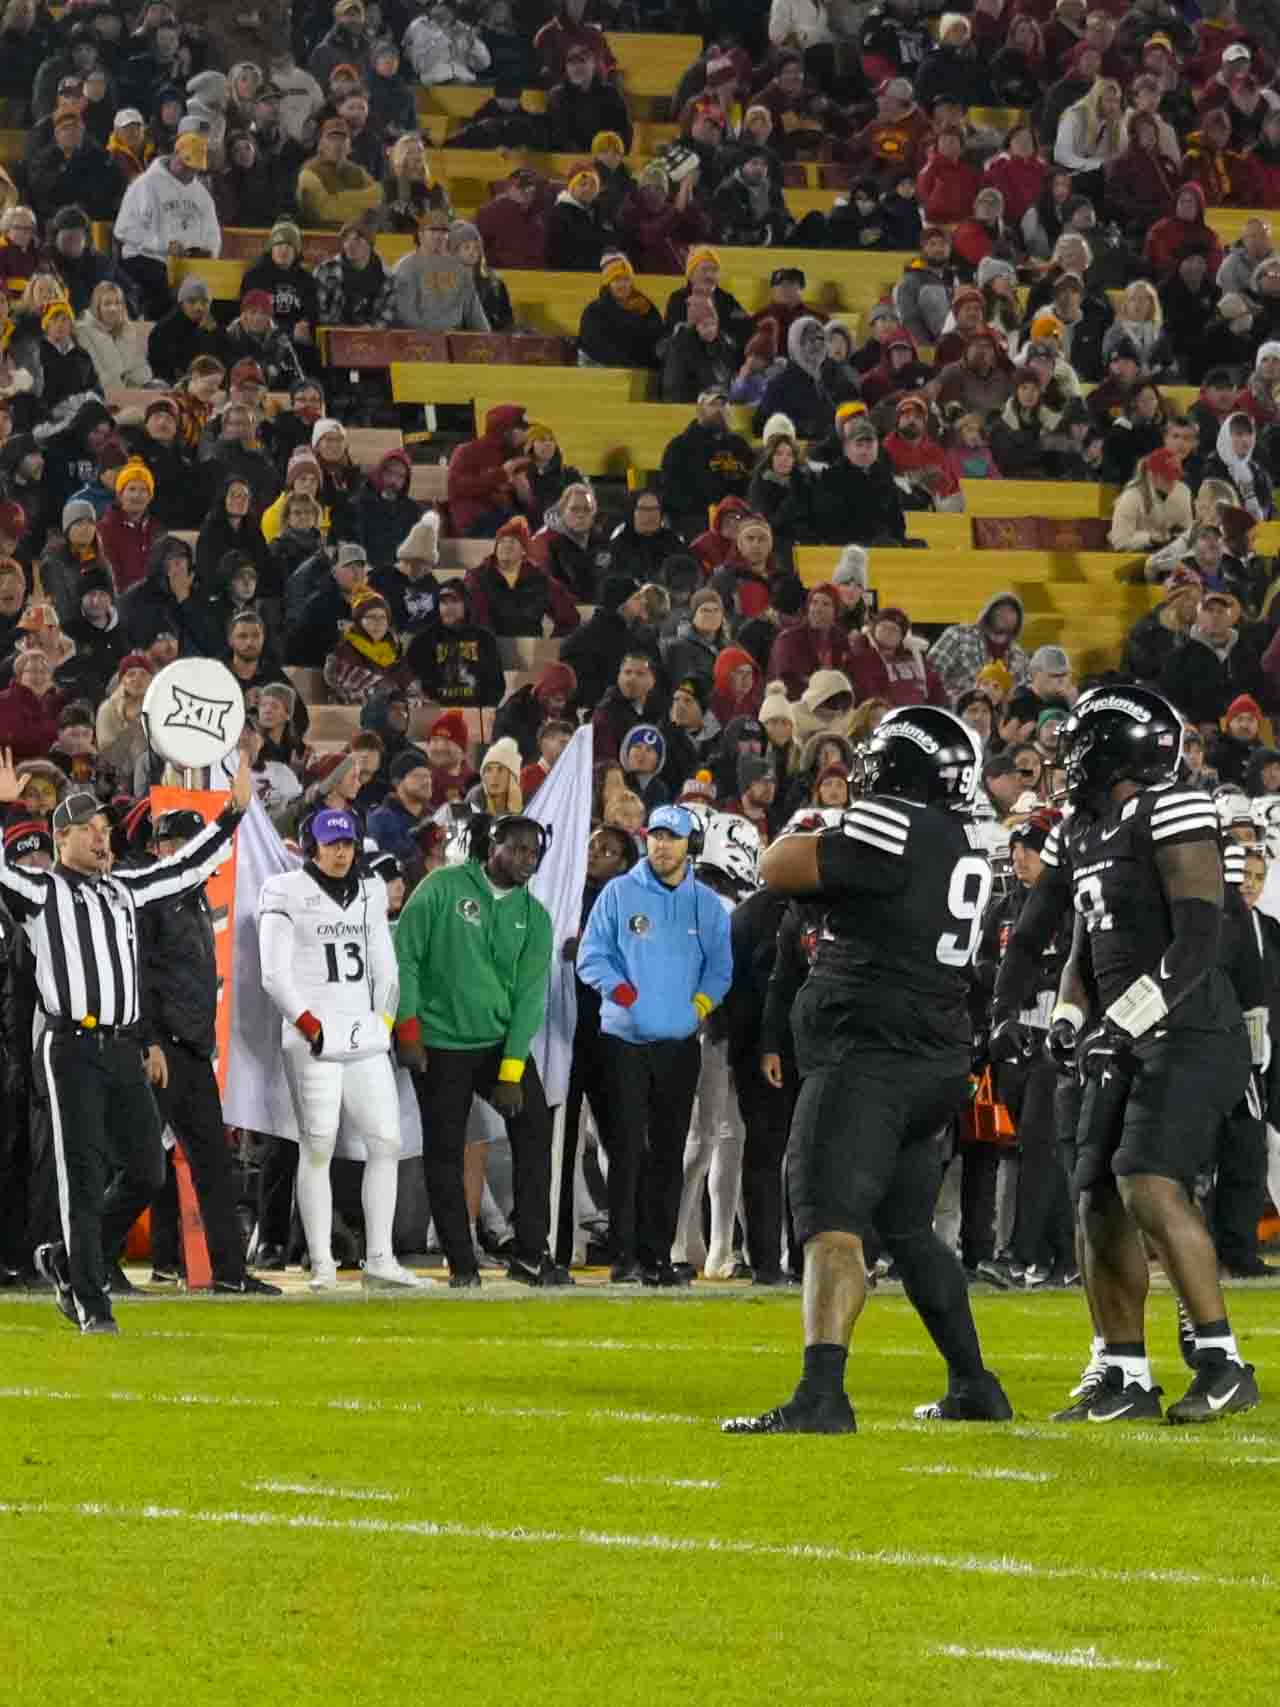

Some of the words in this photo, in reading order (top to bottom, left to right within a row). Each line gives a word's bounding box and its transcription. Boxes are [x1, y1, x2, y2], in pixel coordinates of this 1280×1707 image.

[1078, 696, 1152, 723] Cyclones
[873, 721, 940, 755] Cyclones
[936, 856, 993, 967] 9
[324, 941, 365, 984] 13
